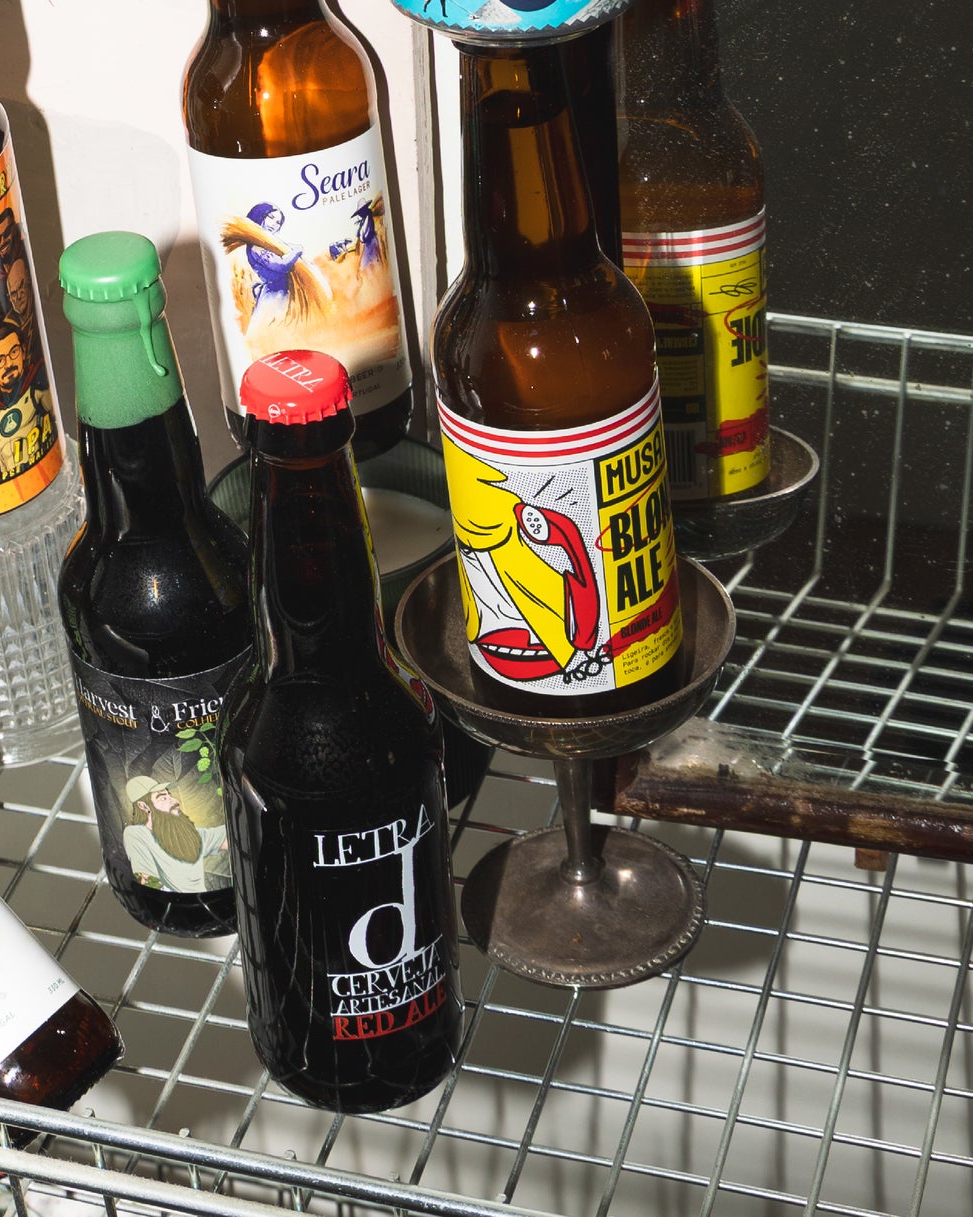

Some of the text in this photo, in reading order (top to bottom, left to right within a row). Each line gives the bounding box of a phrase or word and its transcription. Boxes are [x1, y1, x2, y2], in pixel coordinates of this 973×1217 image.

[291, 158, 371, 211] Seara
[322, 180, 371, 206] PALE LAGER
[259, 352, 324, 393] LETRA
[13, 413, 53, 464] IPA
[606, 438, 664, 496] MUSA
[616, 545, 664, 613] ALE
[620, 606, 663, 639] BLONDE ALE
[622, 657, 639, 668] Para
[74, 672, 137, 721] Harvest
[150, 704, 171, 733] &
[106, 713, 138, 729] STOUT
[313, 804, 435, 868] LETRA
[348, 844, 425, 969] d
[331, 943, 442, 997] CERVEJA
[336, 970, 447, 1016] ARTESANAL
[332, 981, 448, 1041] RED ALE
